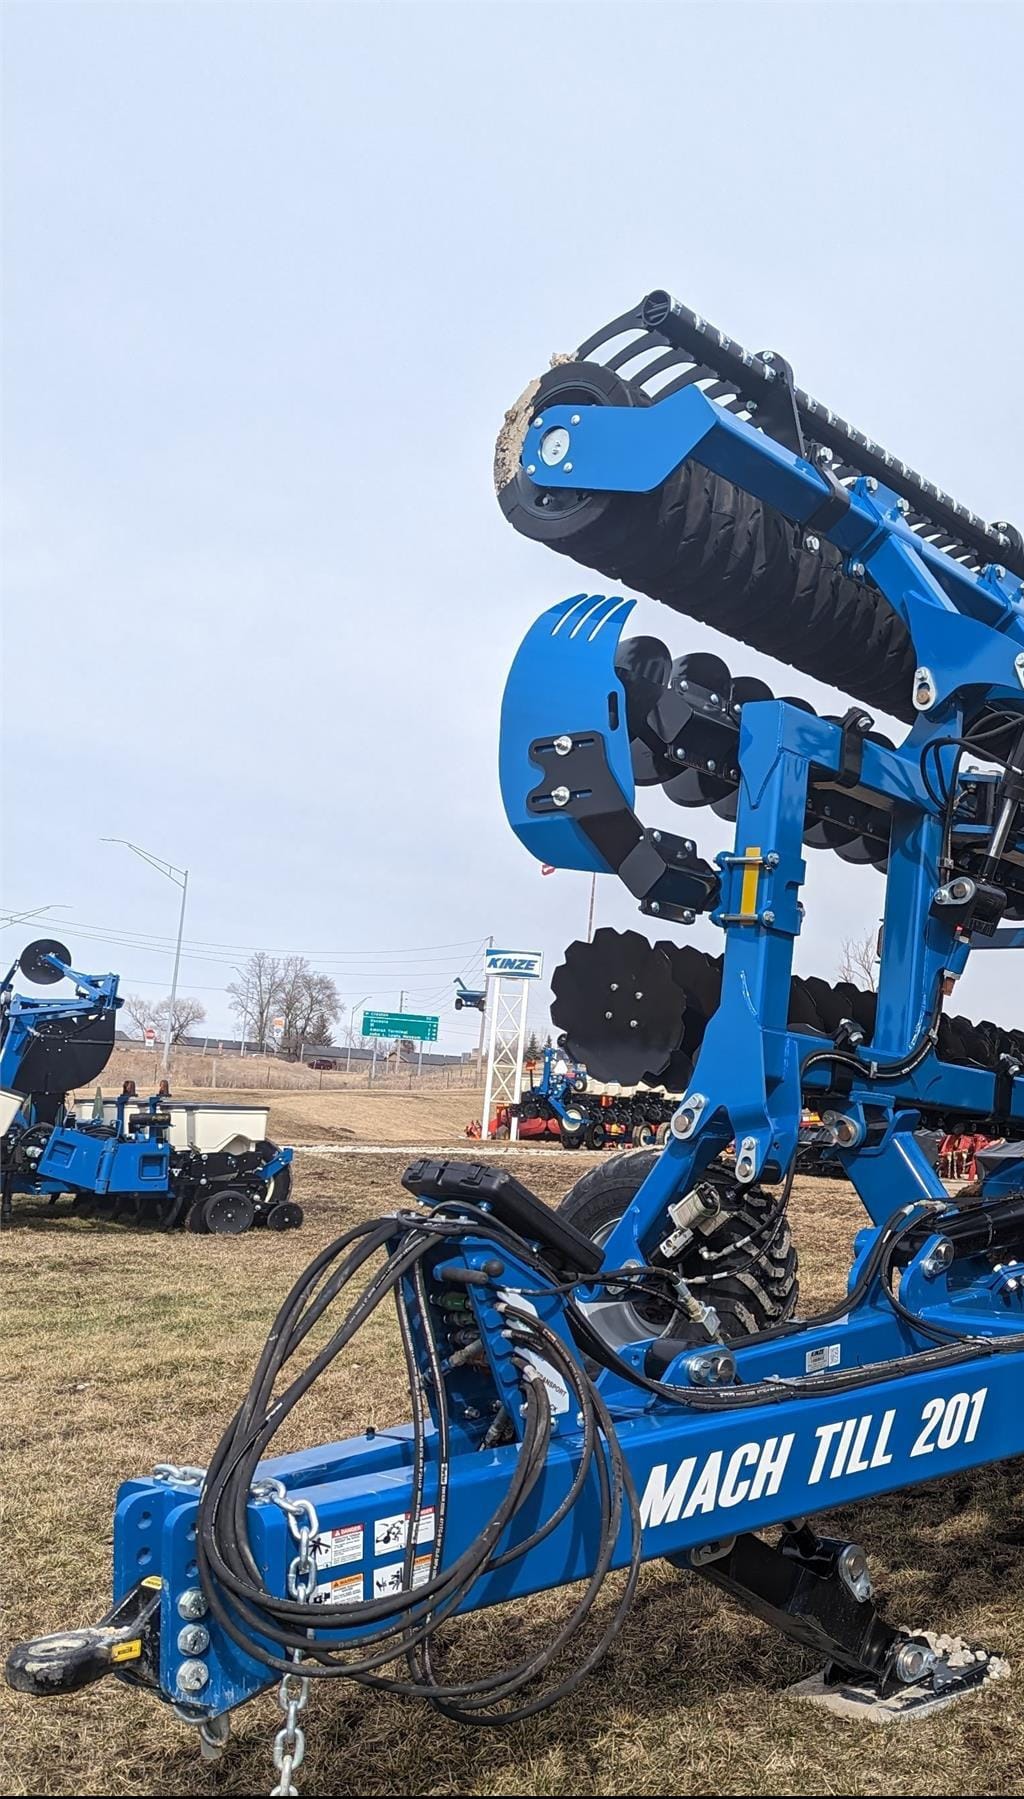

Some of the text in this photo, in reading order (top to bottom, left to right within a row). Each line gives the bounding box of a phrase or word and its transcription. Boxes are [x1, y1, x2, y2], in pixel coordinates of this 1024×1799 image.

[487, 957, 538, 971] KINZE
[639, 1387, 988, 1530] MACH TILL 201
